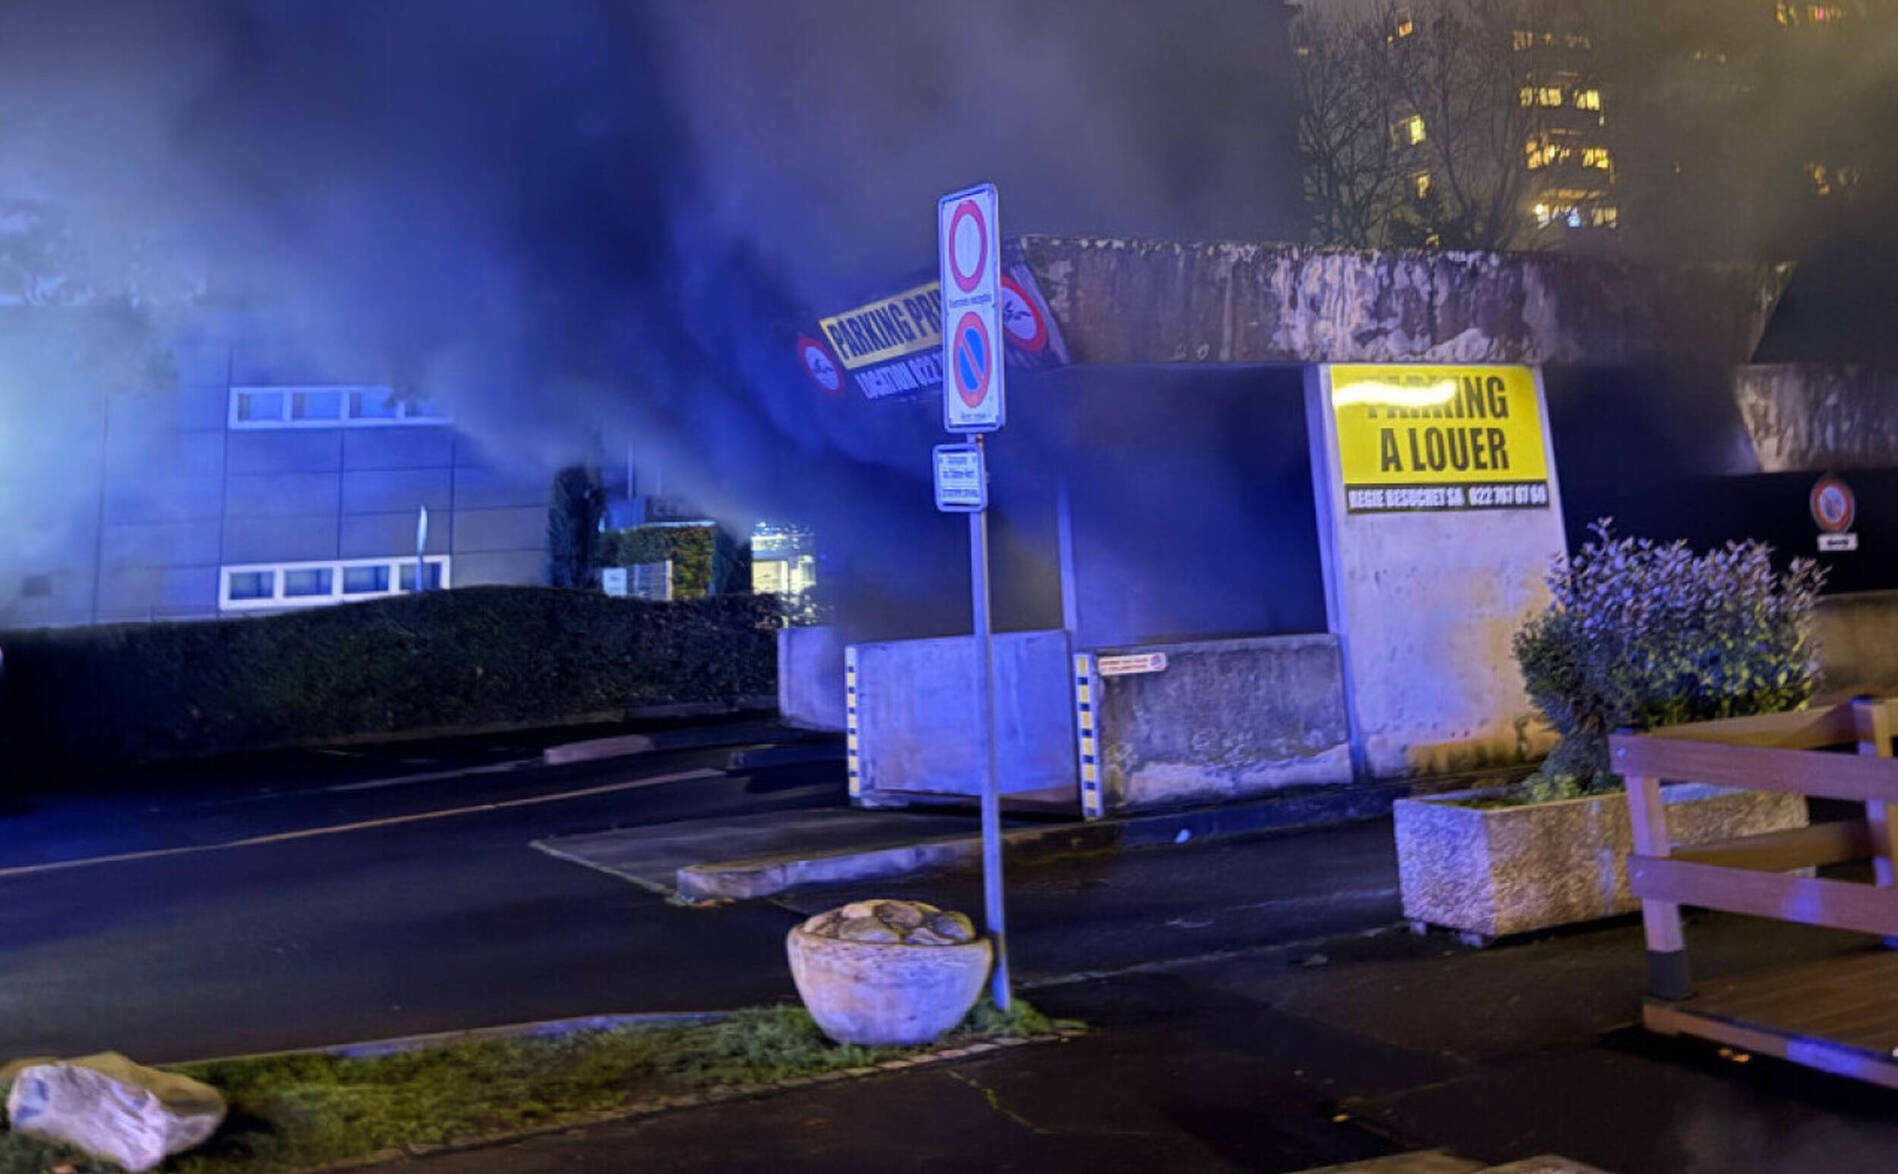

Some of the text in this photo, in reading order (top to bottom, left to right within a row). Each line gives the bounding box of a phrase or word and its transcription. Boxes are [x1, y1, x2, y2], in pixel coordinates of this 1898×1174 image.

[826, 303, 917, 360] PARKING
[1380, 426, 1510, 472] A LOUER
[1469, 486, 1492, 506] 022
